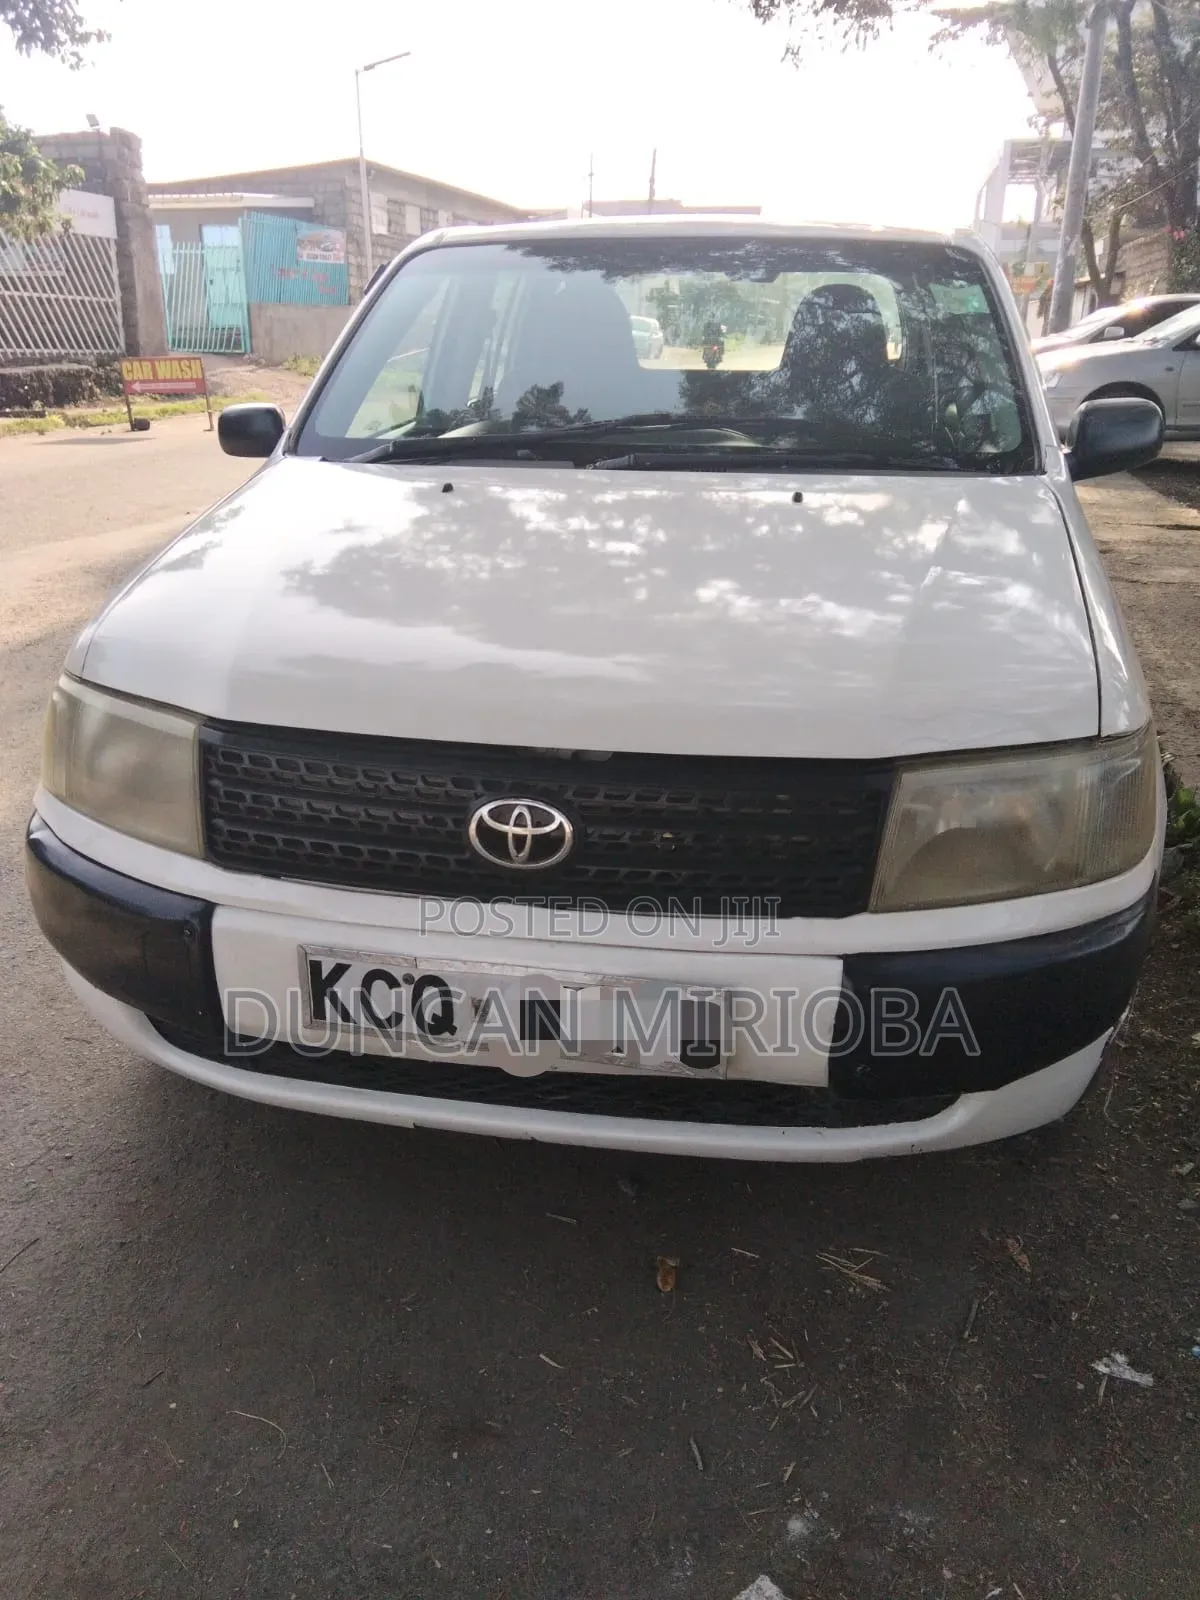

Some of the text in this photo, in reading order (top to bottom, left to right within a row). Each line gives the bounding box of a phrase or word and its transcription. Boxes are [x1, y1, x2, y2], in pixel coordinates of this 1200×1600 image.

[121, 359, 203, 380] CAR WASH
[308, 960, 458, 1036] KCQ
